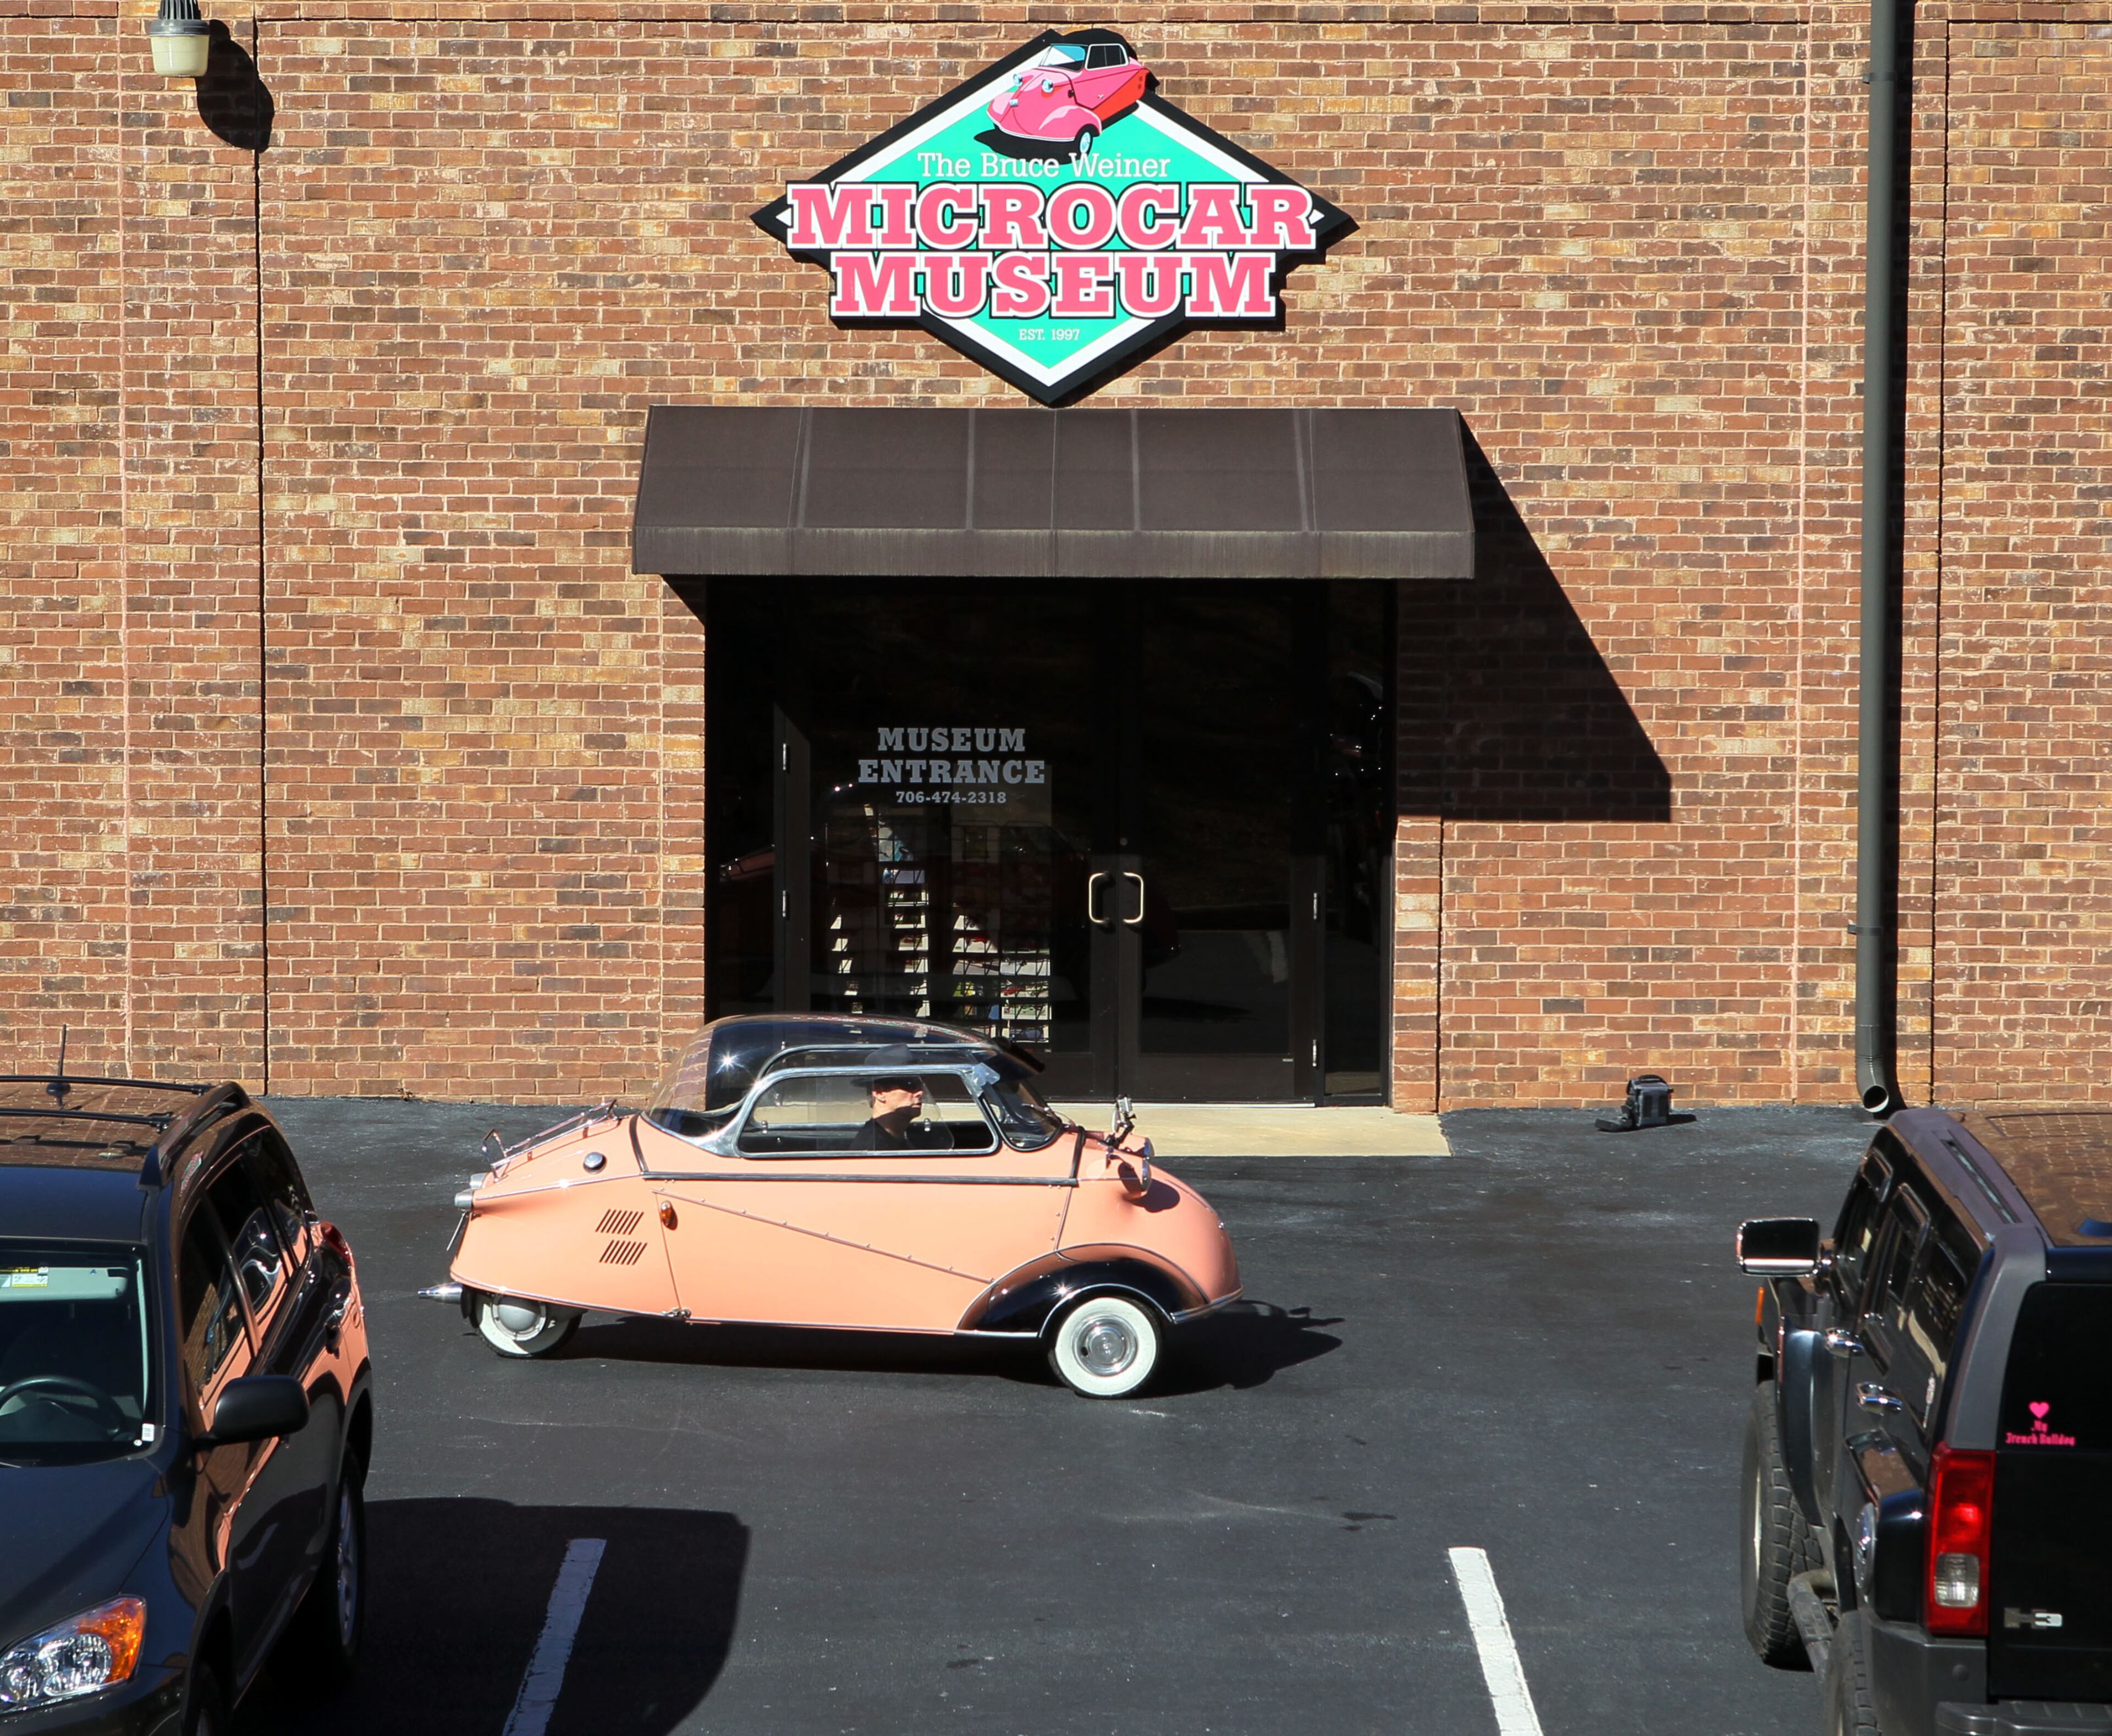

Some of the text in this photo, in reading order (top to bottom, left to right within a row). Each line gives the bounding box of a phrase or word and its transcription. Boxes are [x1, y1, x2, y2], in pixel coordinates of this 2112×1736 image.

[917, 152, 1171, 178] The Bruce Weiner
[788, 182, 1316, 250] MICROCAR
[831, 251, 1277, 318] MUSEUM
[1019, 328, 1080, 341] EST. 1997
[877, 727, 1026, 752] MUSEUM
[857, 759, 1046, 784] ENTRANCE
[895, 790, 1007, 804] 706-474-2318
